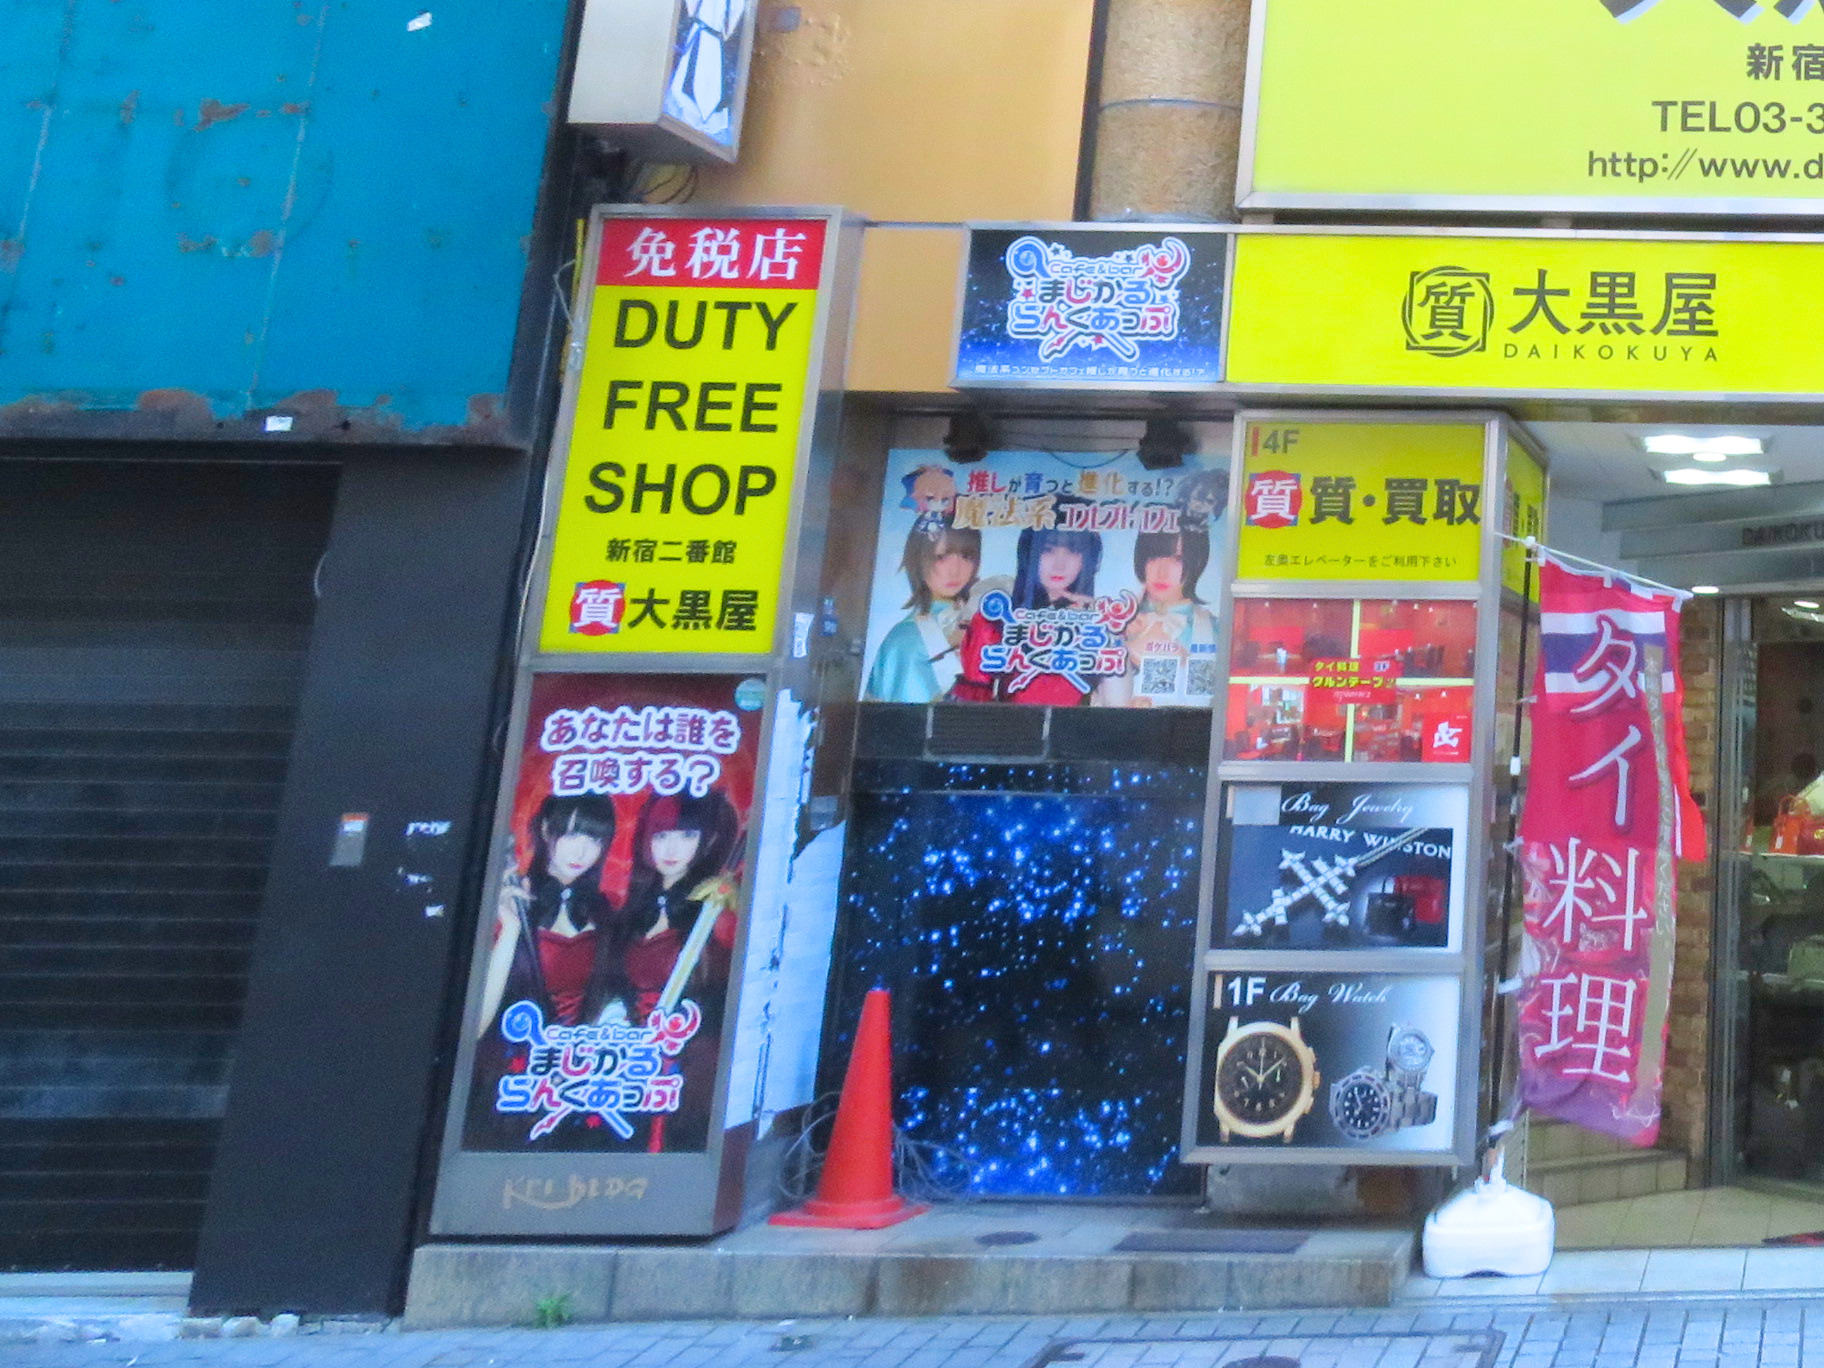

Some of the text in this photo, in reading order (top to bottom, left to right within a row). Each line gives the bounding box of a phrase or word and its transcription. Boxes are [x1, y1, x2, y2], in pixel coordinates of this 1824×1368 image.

[624, 226, 808, 281] 免税店
[1037, 278, 1152, 306] まじかる
[1505, 267, 1720, 338] 大黒屋
[612, 298, 798, 352] DUTY
[1502, 343, 1720, 363] DAIKOKUYA
[602, 379, 783, 433] FREE
[1261, 428, 1301, 456] 4F
[583, 461, 778, 516] SHOP
[1249, 478, 1298, 522] 質
[1308, 475, 1482, 526] 質・買取
[605, 537, 738, 564] 新宿二番館
[573, 586, 760, 632] 質 大黒屋
[1003, 623, 1108, 649] まじかる
[541, 706, 740, 753] あなたは誰を
[553, 753, 720, 797] 召喚する?
[1335, 793, 1413, 825] Jewelry
[1289, 824, 1357, 844] HARRY
[1533, 613, 1649, 1086] タイ料理
[1227, 975, 1393, 1007] 1F Watch
[529, 1045, 662, 1079] まじかる
